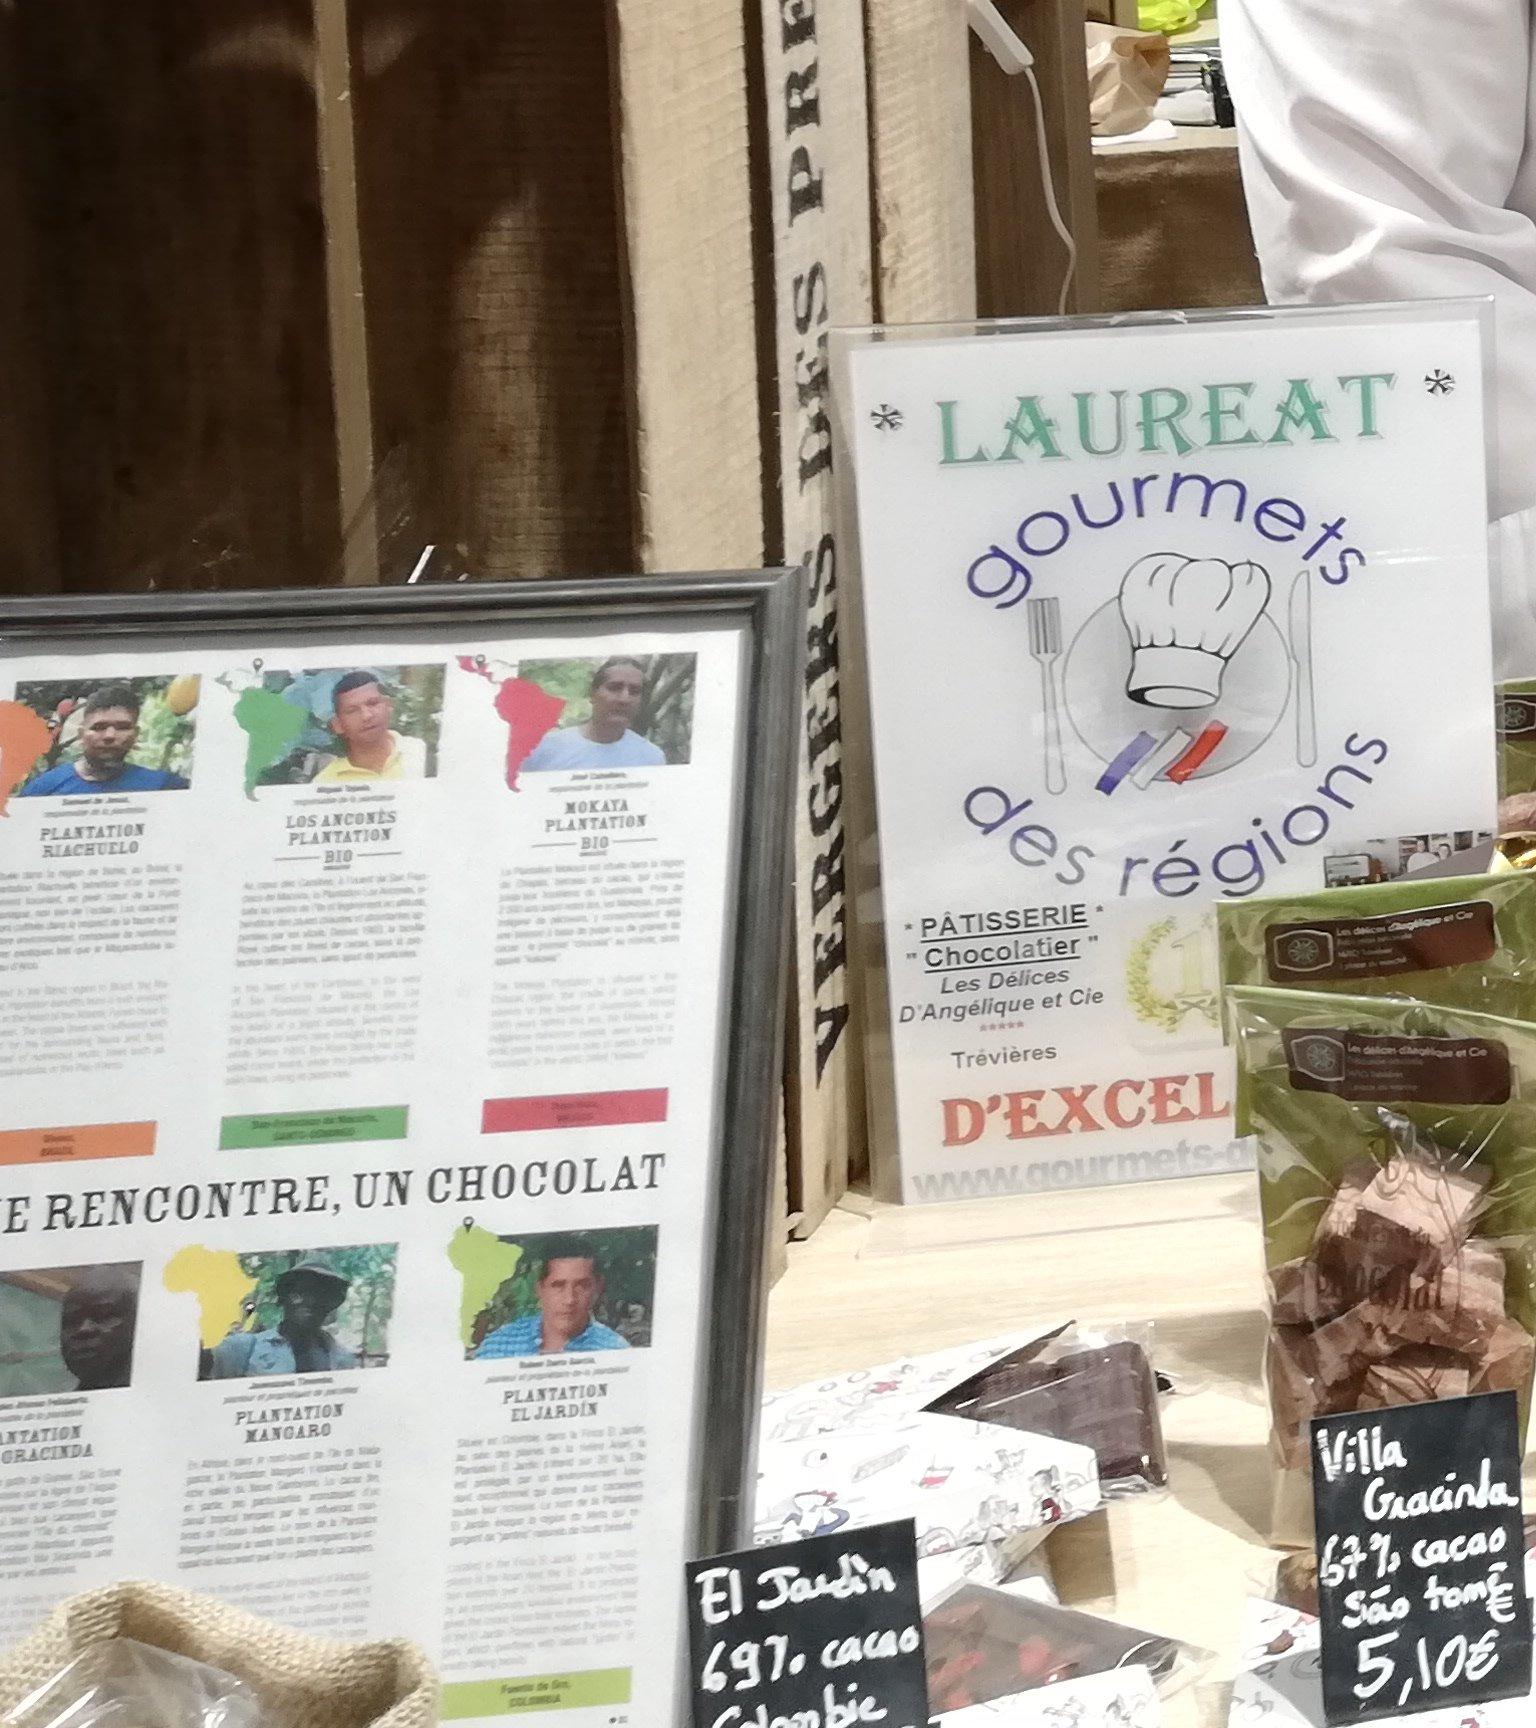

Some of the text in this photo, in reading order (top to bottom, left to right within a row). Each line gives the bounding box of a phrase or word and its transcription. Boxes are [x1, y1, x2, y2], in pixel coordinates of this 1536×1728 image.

[794, 260, 832, 498] DES
[936, 371, 1400, 466] LAUREAT
[966, 471, 1367, 611] gourmets
[286, 807, 397, 829] LOS ANCONÈS
[564, 799, 630, 815] MOKAYA
[802, 531, 850, 1091] VERGERS
[964, 730, 1389, 901] des régions
[40, 823, 146, 842] PLANTATION
[544, 814, 648, 833] PLANTATION
[41, 840, 140, 859] RIACHUELO
[288, 827, 393, 847] PLANTATION
[580, 836, 610, 851] BIO
[324, 849, 354, 864] BIO
[920, 903, 1089, 940] PÂTISSERIE
[924, 935, 1081, 970] Chocolatier
[940, 967, 1071, 995] Les Délices
[899, 987, 1104, 1024] D'Angélique et Cie
[951, 1045, 1058, 1070] Trévières
[0, 1152, 667, 1234] E RENCONTRE, UN CHOCOLAT
[502, 1383, 609, 1405] PLANTATION
[235, 1403, 345, 1426] PLANTATION
[510, 1400, 599, 1423] EL JARDÍN
[244, 1422, 332, 1444] MANGARO
[1, 1443, 94, 1465] GRACINDA
[1316, 1426, 1408, 1482] Villa
[1411, 1527, 1507, 1568] cacao
[694, 1567, 744, 1626] El
[819, 1624, 921, 1670] cacao
